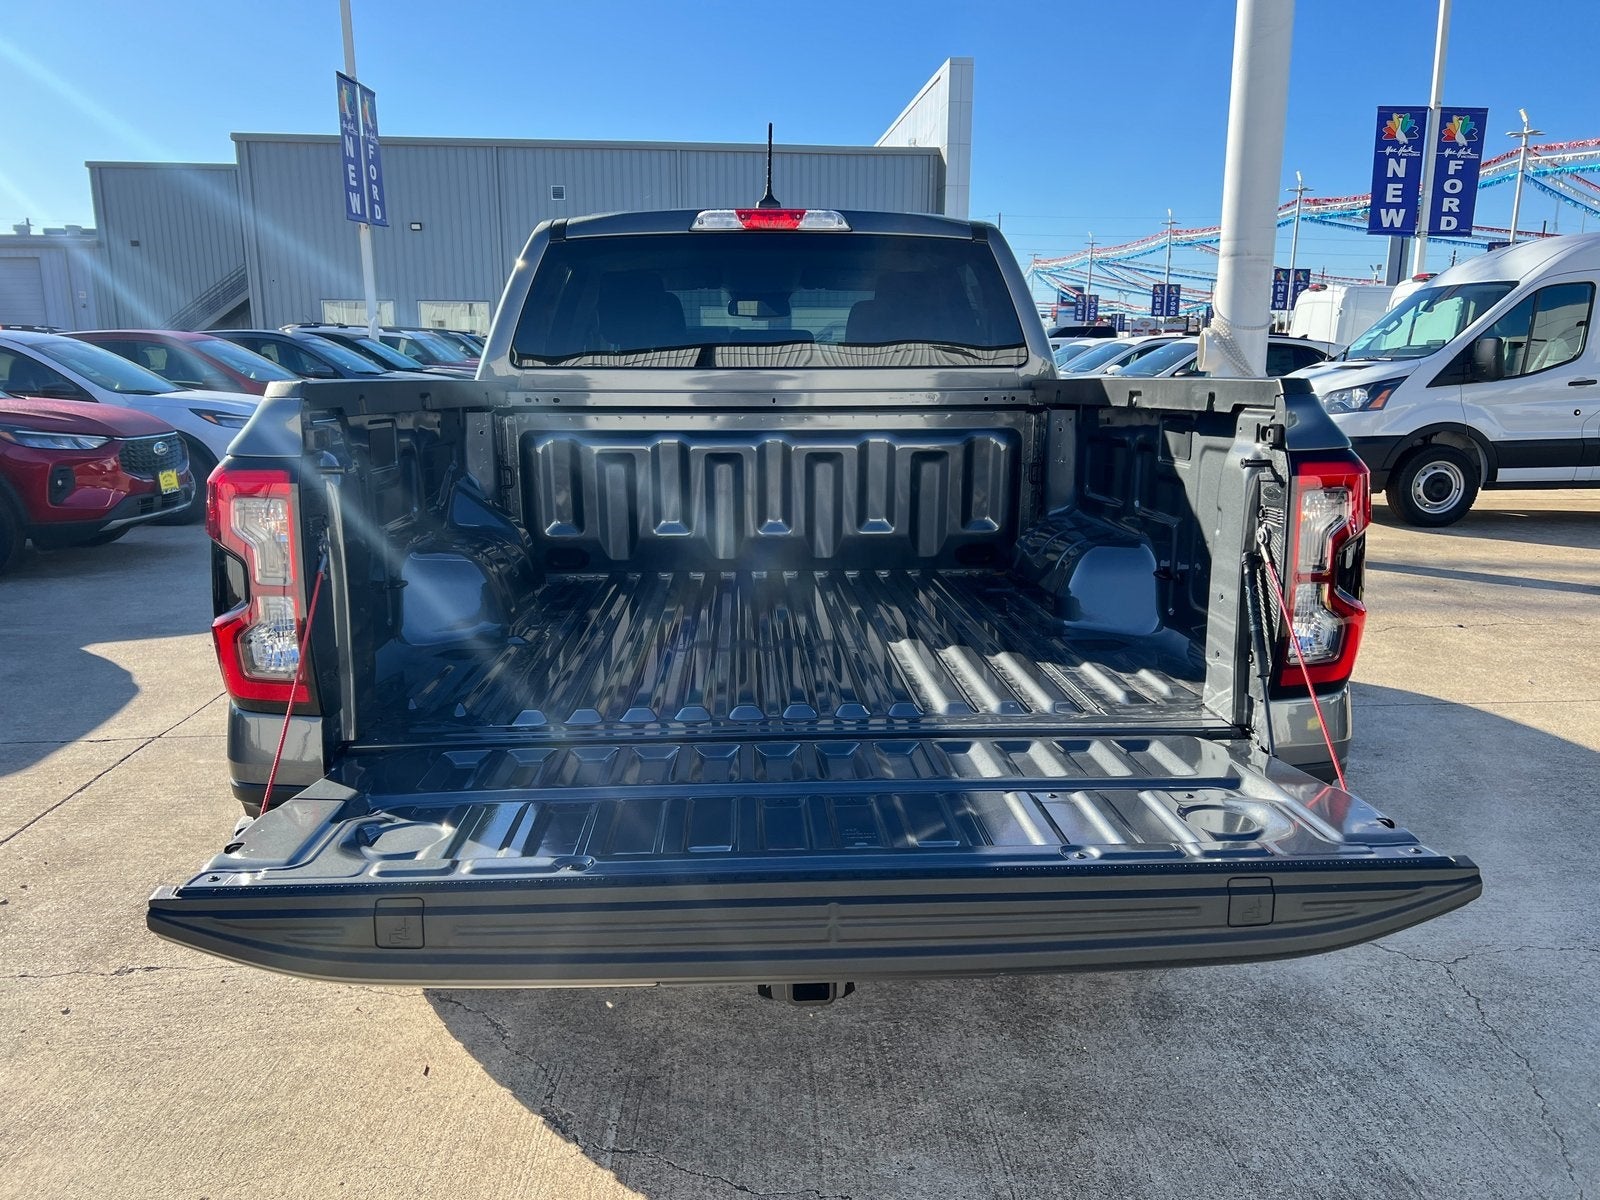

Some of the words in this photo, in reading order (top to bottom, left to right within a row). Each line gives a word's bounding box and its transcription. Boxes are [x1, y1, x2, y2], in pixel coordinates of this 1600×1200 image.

[344, 134, 361, 215] NEW
[367, 144, 382, 220] FORD
[1380, 158, 1407, 228] NEW
[1440, 160, 1464, 231] FORD
[1154, 296, 1162, 315] NEW
[1275, 285, 1285, 309] NEW
